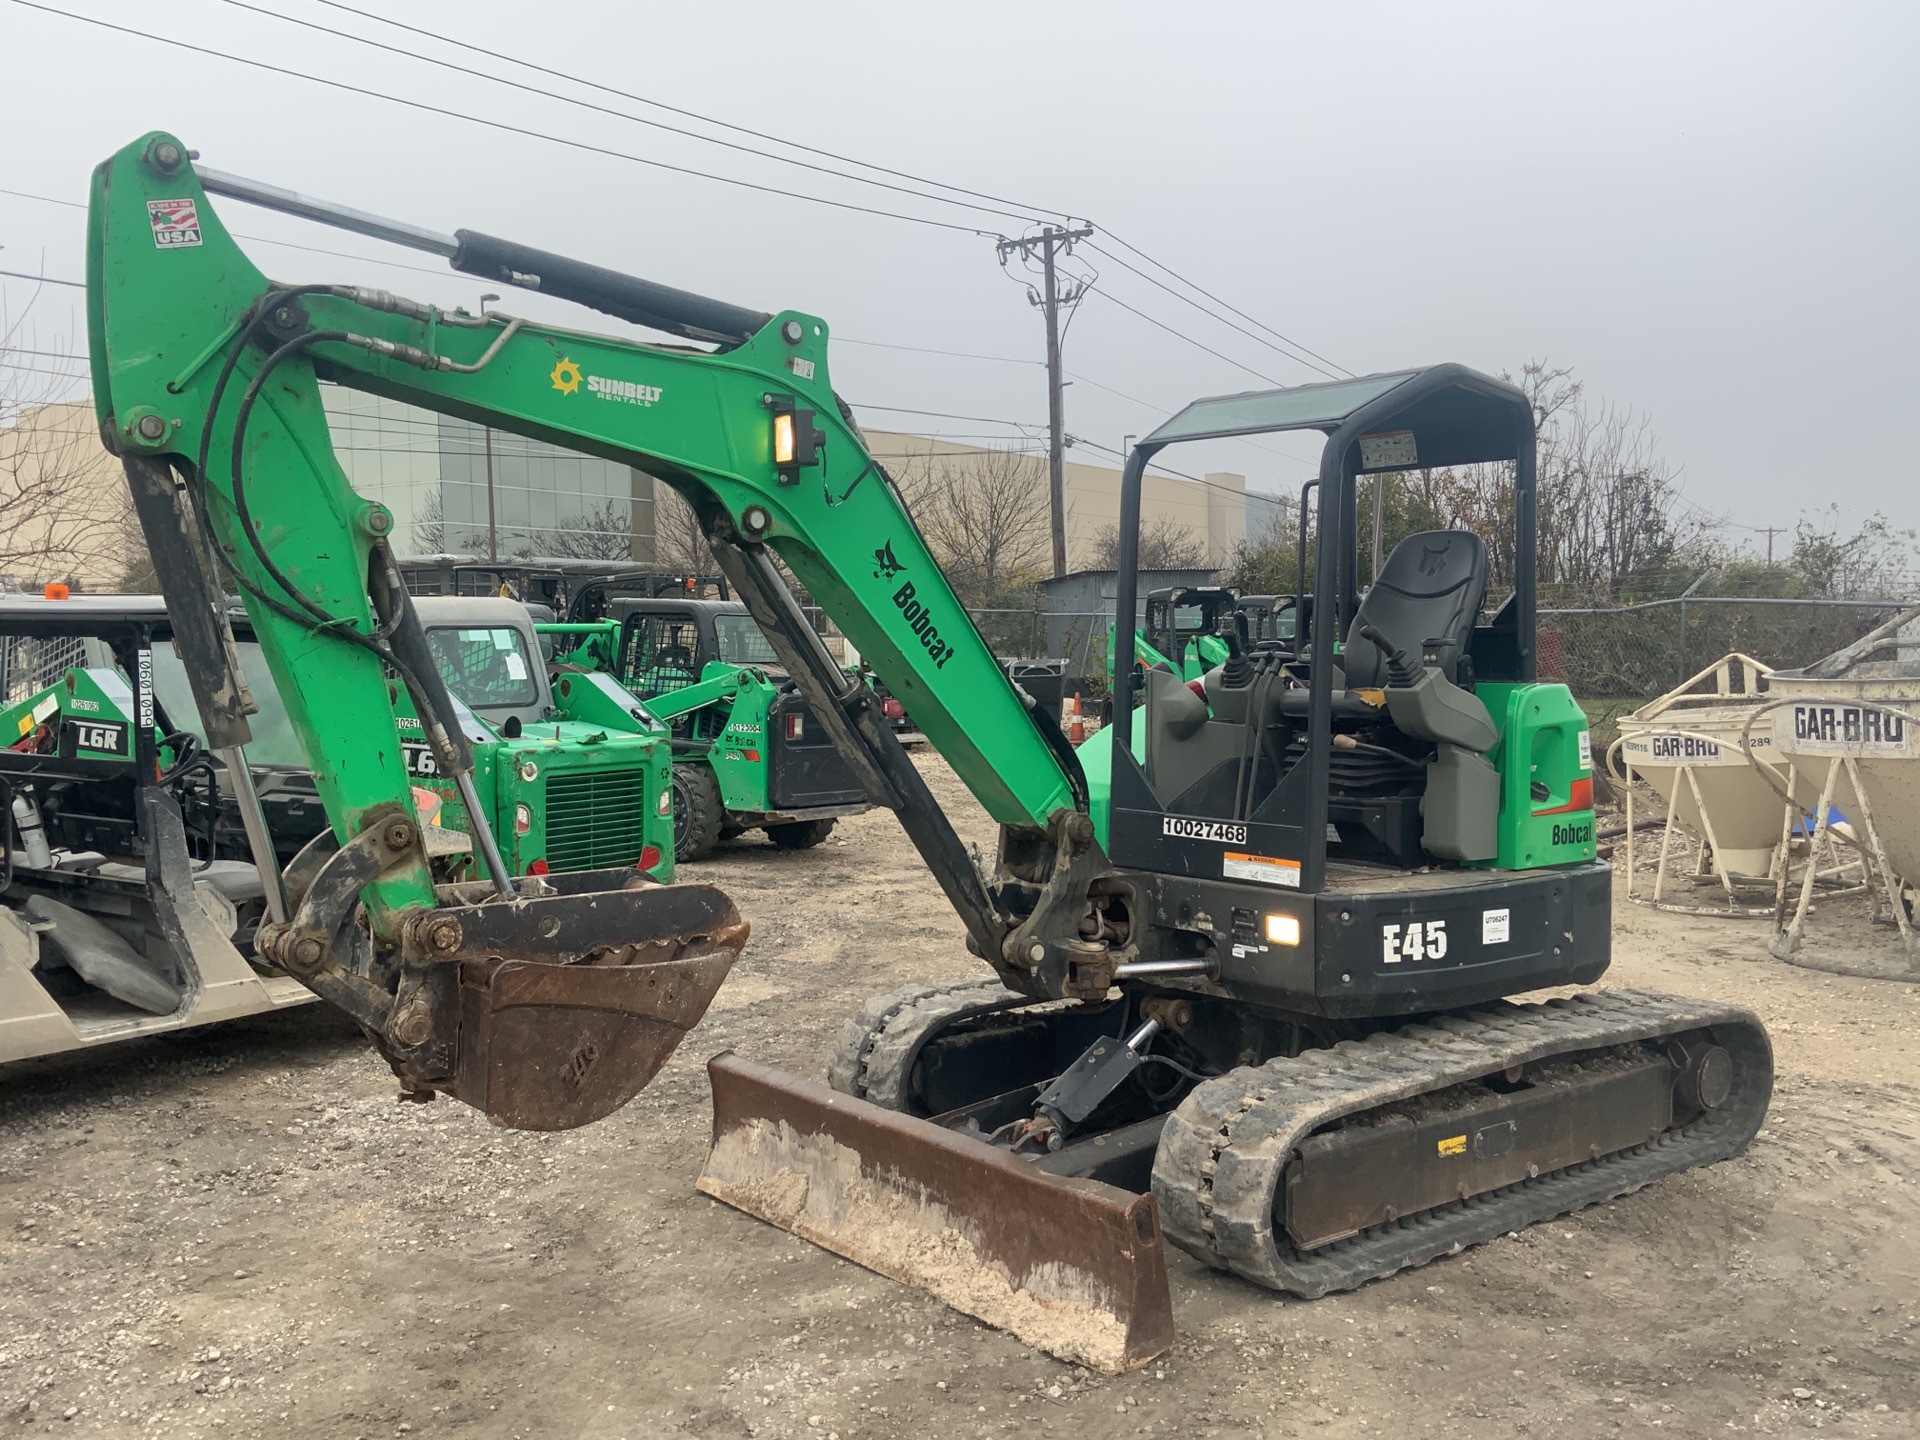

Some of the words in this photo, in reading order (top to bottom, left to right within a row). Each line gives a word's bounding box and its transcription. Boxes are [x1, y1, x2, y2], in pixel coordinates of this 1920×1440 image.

[157, 230, 199, 243] USA
[587, 375, 663, 402] SUNBELT
[597, 392, 652, 408] RENTALS
[892, 580, 955, 670] Bobcat
[139, 652, 154, 727] 10601099
[1795, 706, 1903, 742] GAR-BRO
[79, 727, 118, 750] L6R
[1652, 737, 1719, 757] GAR-BRO
[1165, 818, 1246, 843] 10027468
[1552, 822, 1592, 846] Bobcat
[1254, 856, 1276, 865] WARNING
[1383, 920, 1447, 963] E45
